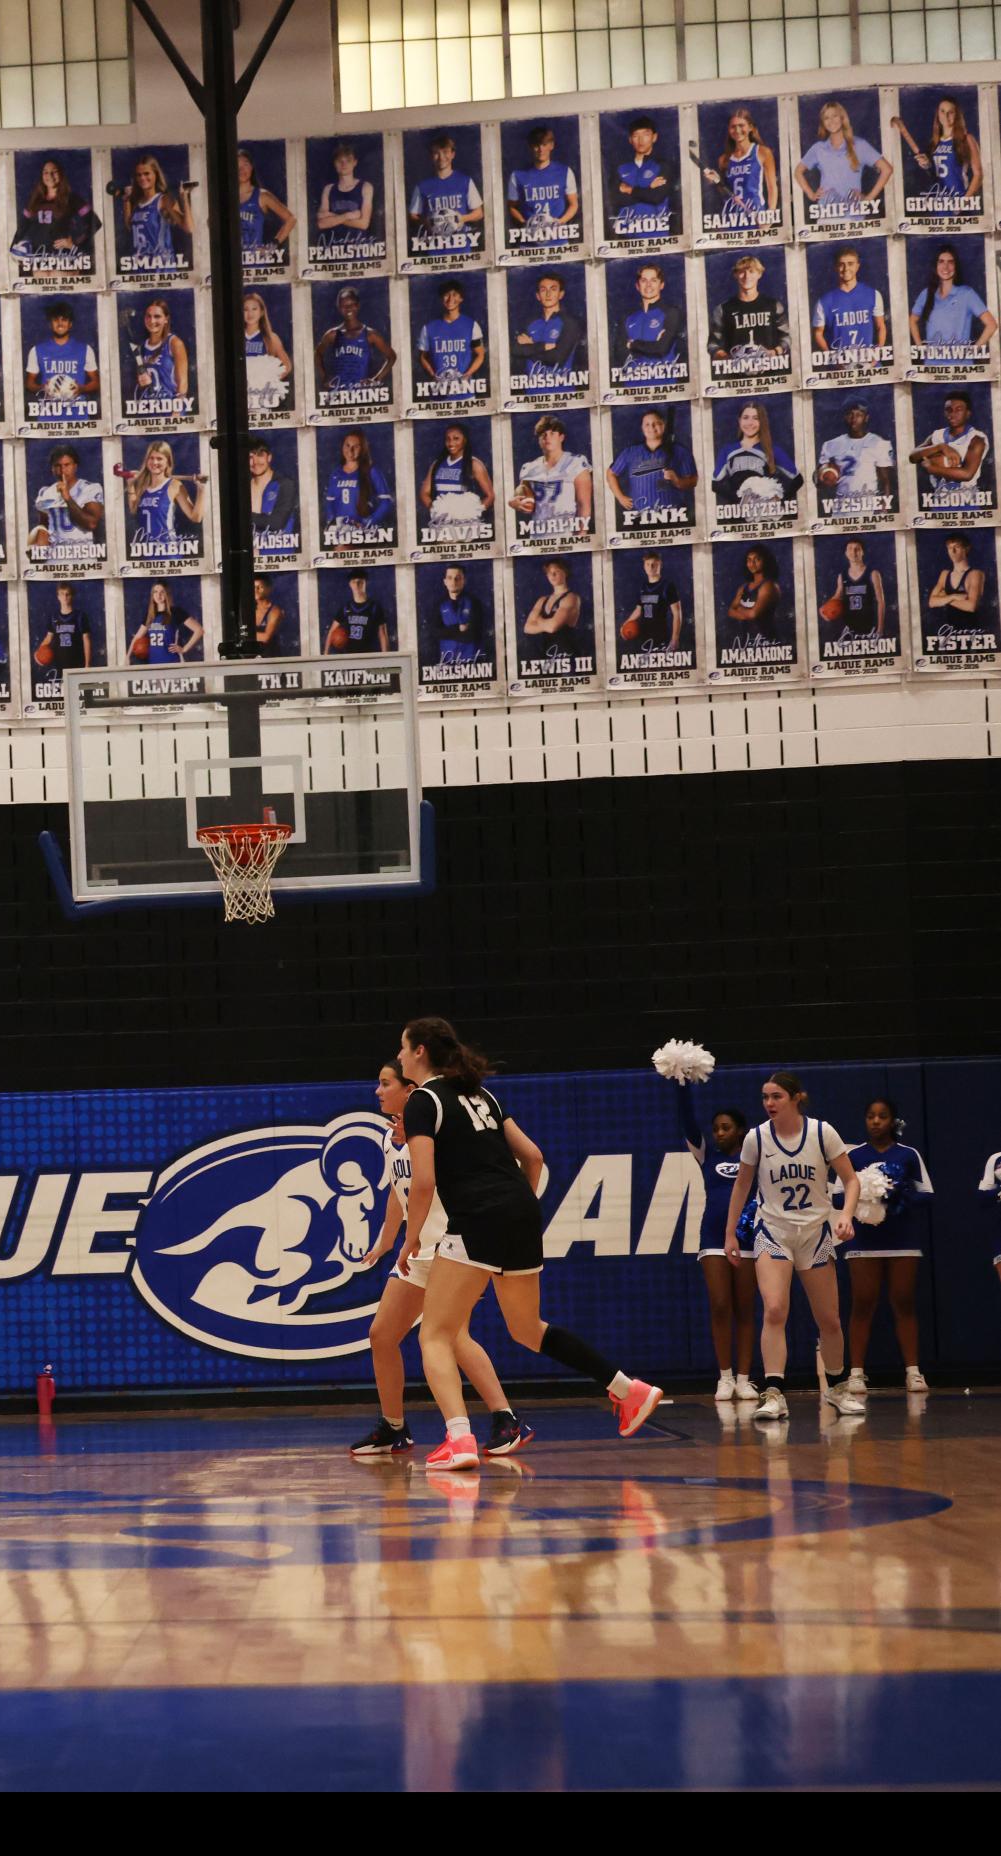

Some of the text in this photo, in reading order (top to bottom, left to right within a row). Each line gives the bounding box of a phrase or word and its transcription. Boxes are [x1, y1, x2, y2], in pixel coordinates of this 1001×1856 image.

[524, 185, 560, 201] LADUE
[534, 203, 549, 216] 24
[809, 199, 881, 219] SHIPLEY
[615, 216, 669, 235] CHOE
[703, 209, 782, 229] SALVATORI
[810, 221, 881, 232] LADUE RAMS
[910, 217, 979, 226] LADUE RAMS
[509, 224, 579, 243] PRANGE
[309, 241, 385, 261] PEARLSTONE
[413, 254, 481, 265] LADUE RAMS
[510, 245, 578, 257] LADUE RAMS
[120, 254, 188, 269] SMALL
[25, 277, 60, 285] LADUE
[734, 312, 771, 328] LADUE
[835, 310, 869, 326] LADUE
[434, 339, 466, 352] LADUE
[911, 345, 990, 360] STOCKWELL
[44, 360, 77, 374] LADUE
[711, 354, 789, 375] THOMPSON
[416, 378, 486, 397] HWANG
[510, 370, 589, 389] GROSSMAN
[319, 387, 389, 406] PERKINS
[615, 385, 685, 396] LADUE RAMS
[822, 495, 893, 514] WESLEY
[623, 507, 688, 526] FINK
[421, 525, 492, 543] DAVIS
[519, 516, 591, 536] MURPHY
[622, 529, 691, 540] LADUE RAMS
[324, 528, 393, 545] ROSEN
[31, 544, 106, 560] HENDERSON
[130, 540, 198, 557] DURBIN
[150, 633, 164, 646] 22
[823, 638, 896, 657] ANDERSON
[926, 634, 997, 651] FISTER
[620, 651, 691, 670] ANDERSON
[721, 646, 792, 664] AMARAKONE
[929, 656, 965, 664] LADUE
[422, 664, 494, 681] ENGELSMANN
[520, 656, 592, 676] LEWIS III
[324, 670, 391, 686] KAUFMA
[623, 672, 690, 682] LADUE RAMS
[132, 678, 200, 694] CALVERT
[458, 1096, 498, 1131] 12
[769, 1163, 816, 1184] LADUE
[780, 1184, 813, 1211] 22
